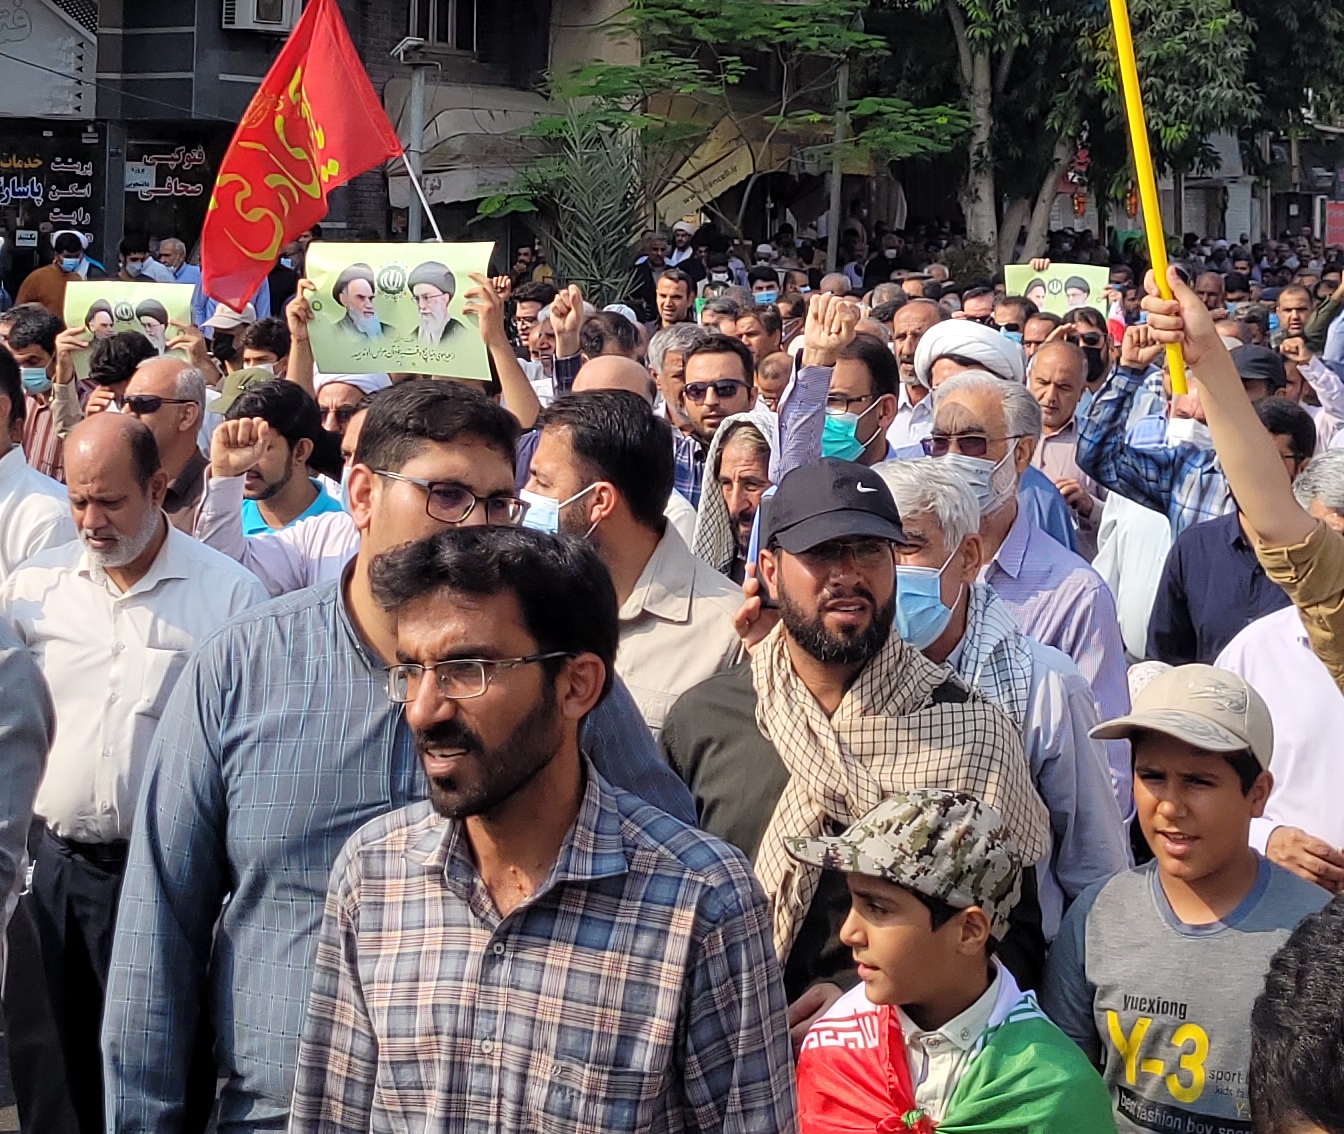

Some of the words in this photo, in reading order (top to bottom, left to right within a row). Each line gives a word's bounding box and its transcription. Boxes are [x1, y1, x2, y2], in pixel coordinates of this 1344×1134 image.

[0, 152, 43, 170] خدمات
[50, 157, 93, 177] پرینت
[141, 144, 206, 170] فتوکپی
[48, 183, 92, 201] اسکن
[137, 175, 204, 201] صحافی
[48, 207, 91, 225] رایت
[1122, 993, 1188, 1020] yuexiong
[1106, 1009, 1210, 1103] Y-3
[1120, 1090, 1137, 1115] best
[1136, 1099, 1182, 1130] fashion
[1186, 1116, 1214, 1134] boy
[1235, 1101, 1252, 1118] Y-
